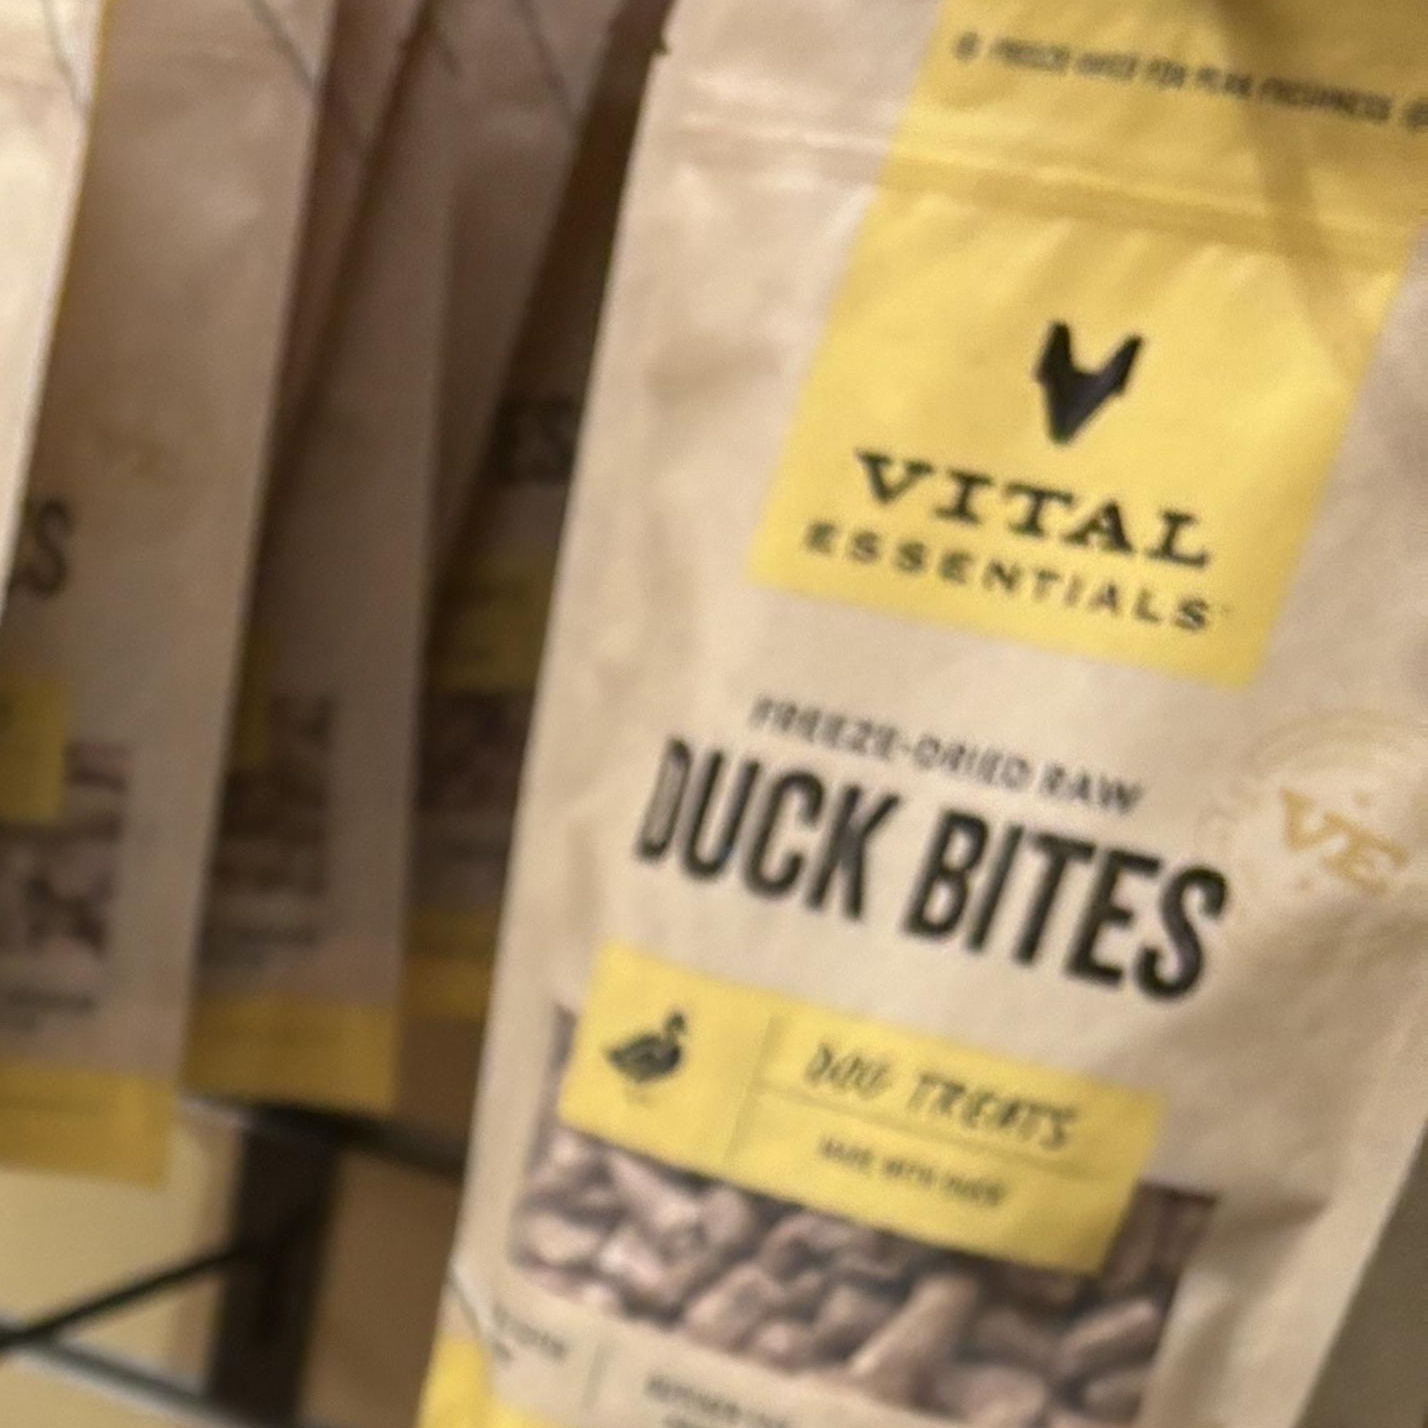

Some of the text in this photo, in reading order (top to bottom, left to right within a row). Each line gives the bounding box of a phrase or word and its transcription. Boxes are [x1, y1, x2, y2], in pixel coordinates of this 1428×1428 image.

[856, 447, 1212, 569] VITAL
[804, 519, 1211, 631] ESSENTIALS
[748, 697, 1144, 814] FREEZE-DRIED RAW
[634, 738, 1230, 1002] DUCK BITES
